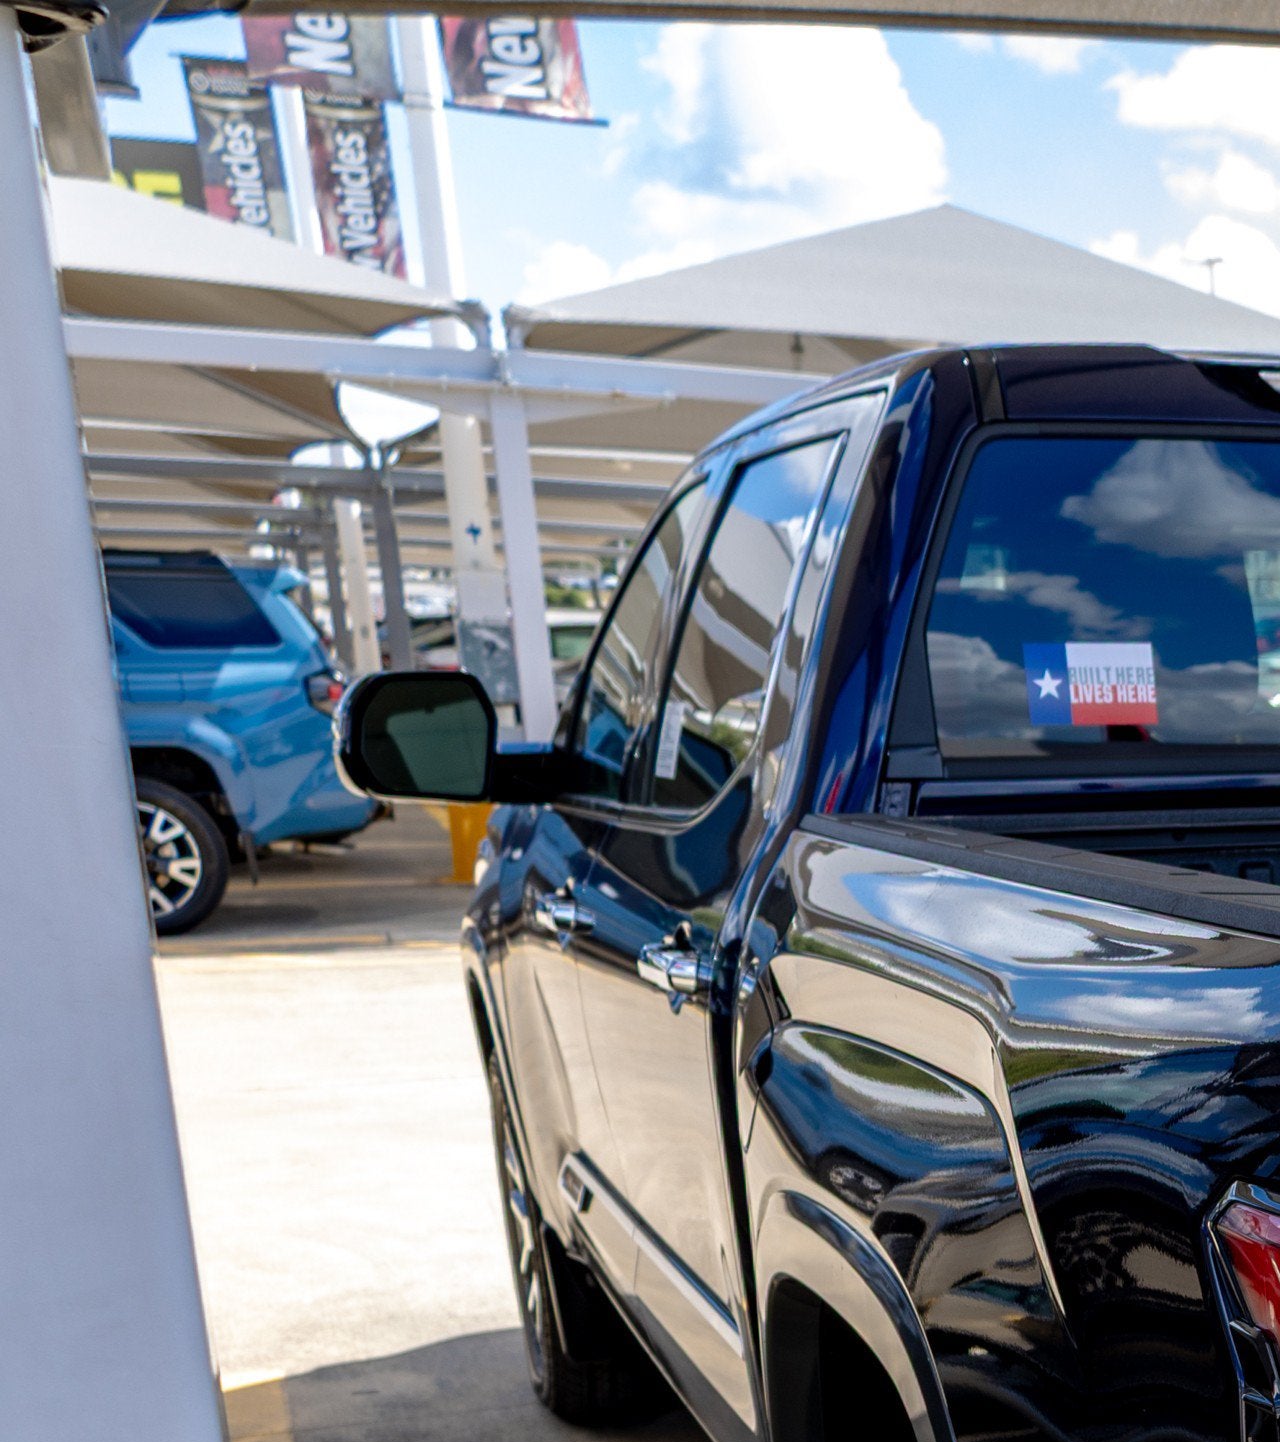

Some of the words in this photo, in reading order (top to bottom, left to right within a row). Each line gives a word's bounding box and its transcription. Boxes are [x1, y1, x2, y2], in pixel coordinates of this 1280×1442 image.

[284, 13, 354, 76] Ne
[330, 129, 379, 250] Vehicles
[1068, 666, 1113, 686] BUILT
[1115, 666, 1154, 686] HERE
[1069, 684, 1114, 704] LIVES
[1117, 684, 1157, 704] HERE
